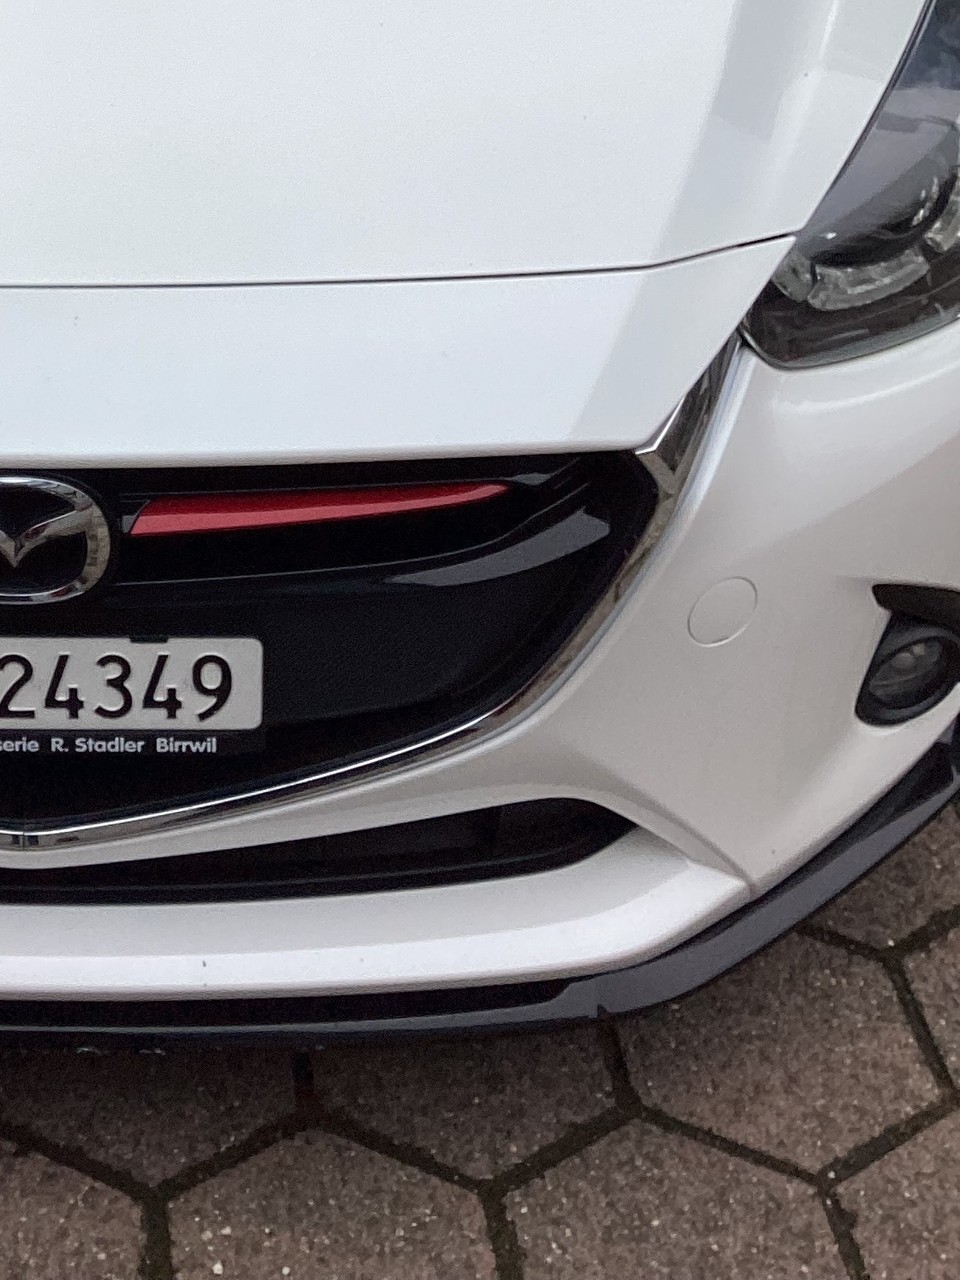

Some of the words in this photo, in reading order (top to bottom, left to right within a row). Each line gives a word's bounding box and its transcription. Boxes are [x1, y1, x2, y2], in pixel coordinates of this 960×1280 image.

[50, 736, 69, 753] R.
[74, 736, 145, 753] Stadler
[155, 736, 218, 753] Birrwil
